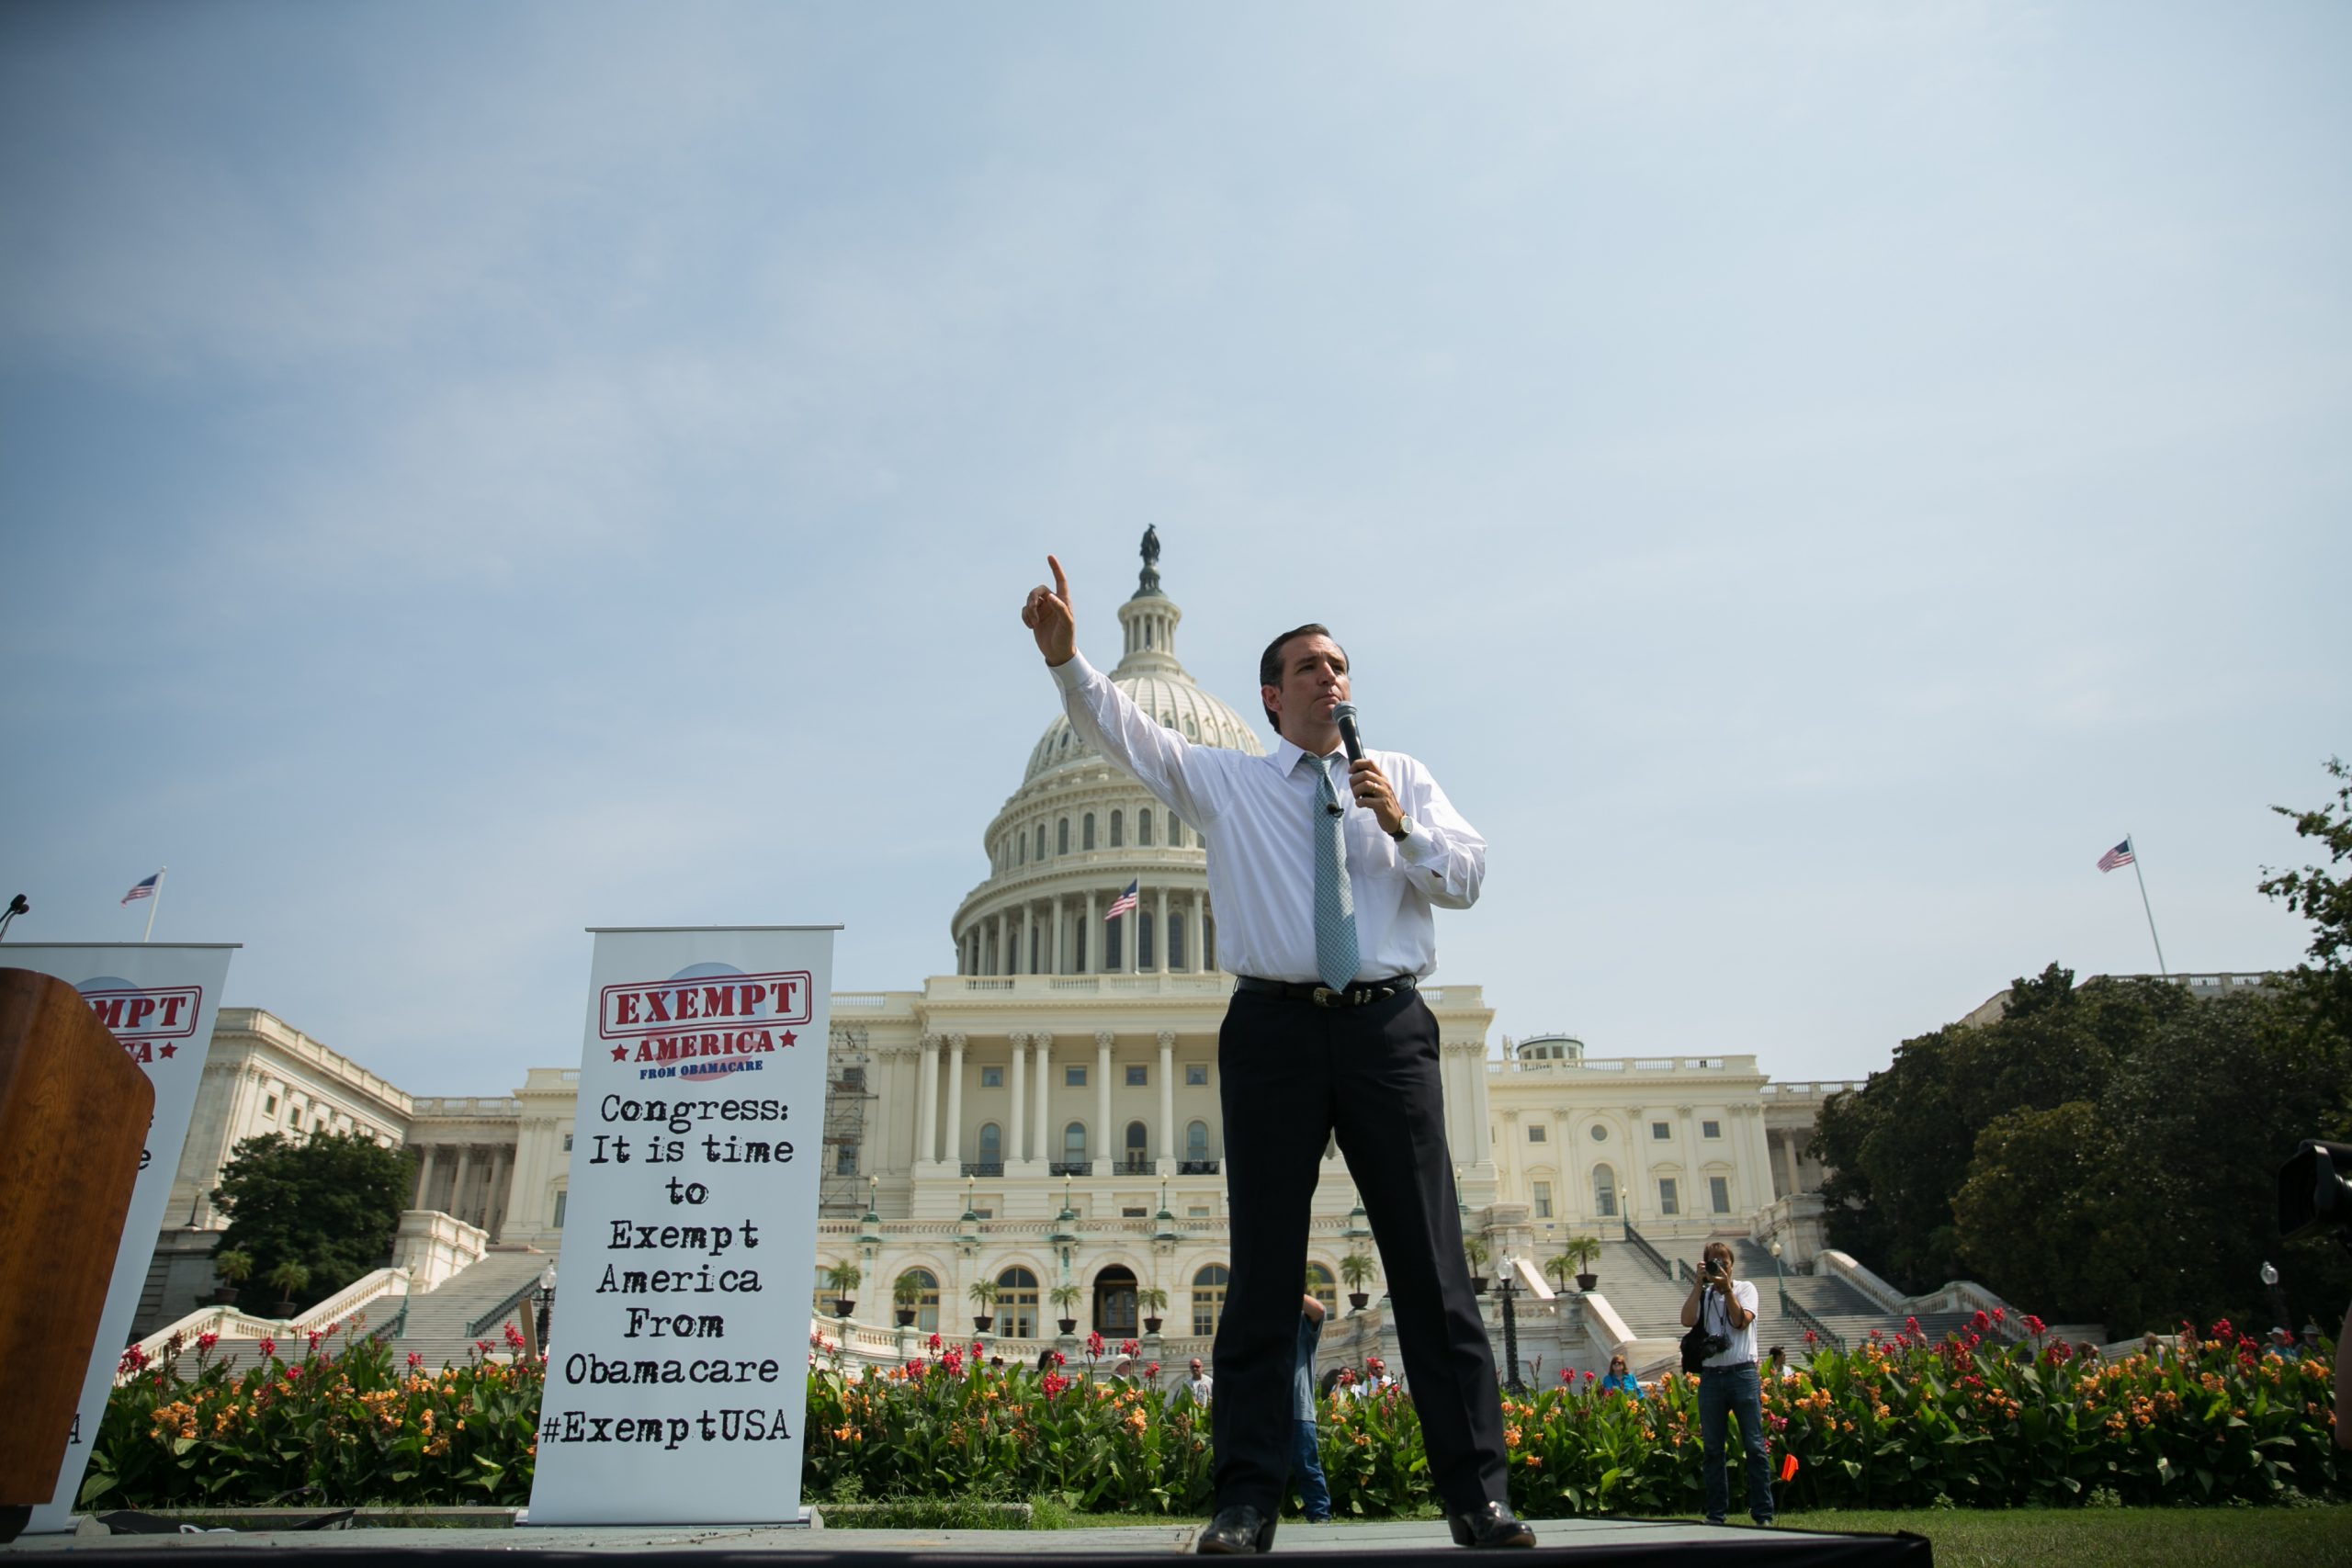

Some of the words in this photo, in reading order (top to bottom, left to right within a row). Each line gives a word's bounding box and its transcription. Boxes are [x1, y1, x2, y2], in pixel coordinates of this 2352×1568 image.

[615, 982, 797, 1025] EXEMPT
[634, 1030, 775, 1063] AMERICA
[639, 1066, 676, 1080] FROM
[680, 1060, 763, 1077] OBAMACARE
[601, 1094, 788, 1134] Congress:
[589, 1135, 631, 1164] It
[645, 1136, 684, 1163] is
[701, 1134, 794, 1164] time
[664, 1176, 709, 1205] to
[607, 1219, 759, 1256] Exempt
[595, 1263, 763, 1293] America
[623, 1307, 725, 1337] From
[565, 1353, 779, 1384] Obamacare
[542, 1408, 792, 1450] #ExemptUSA
